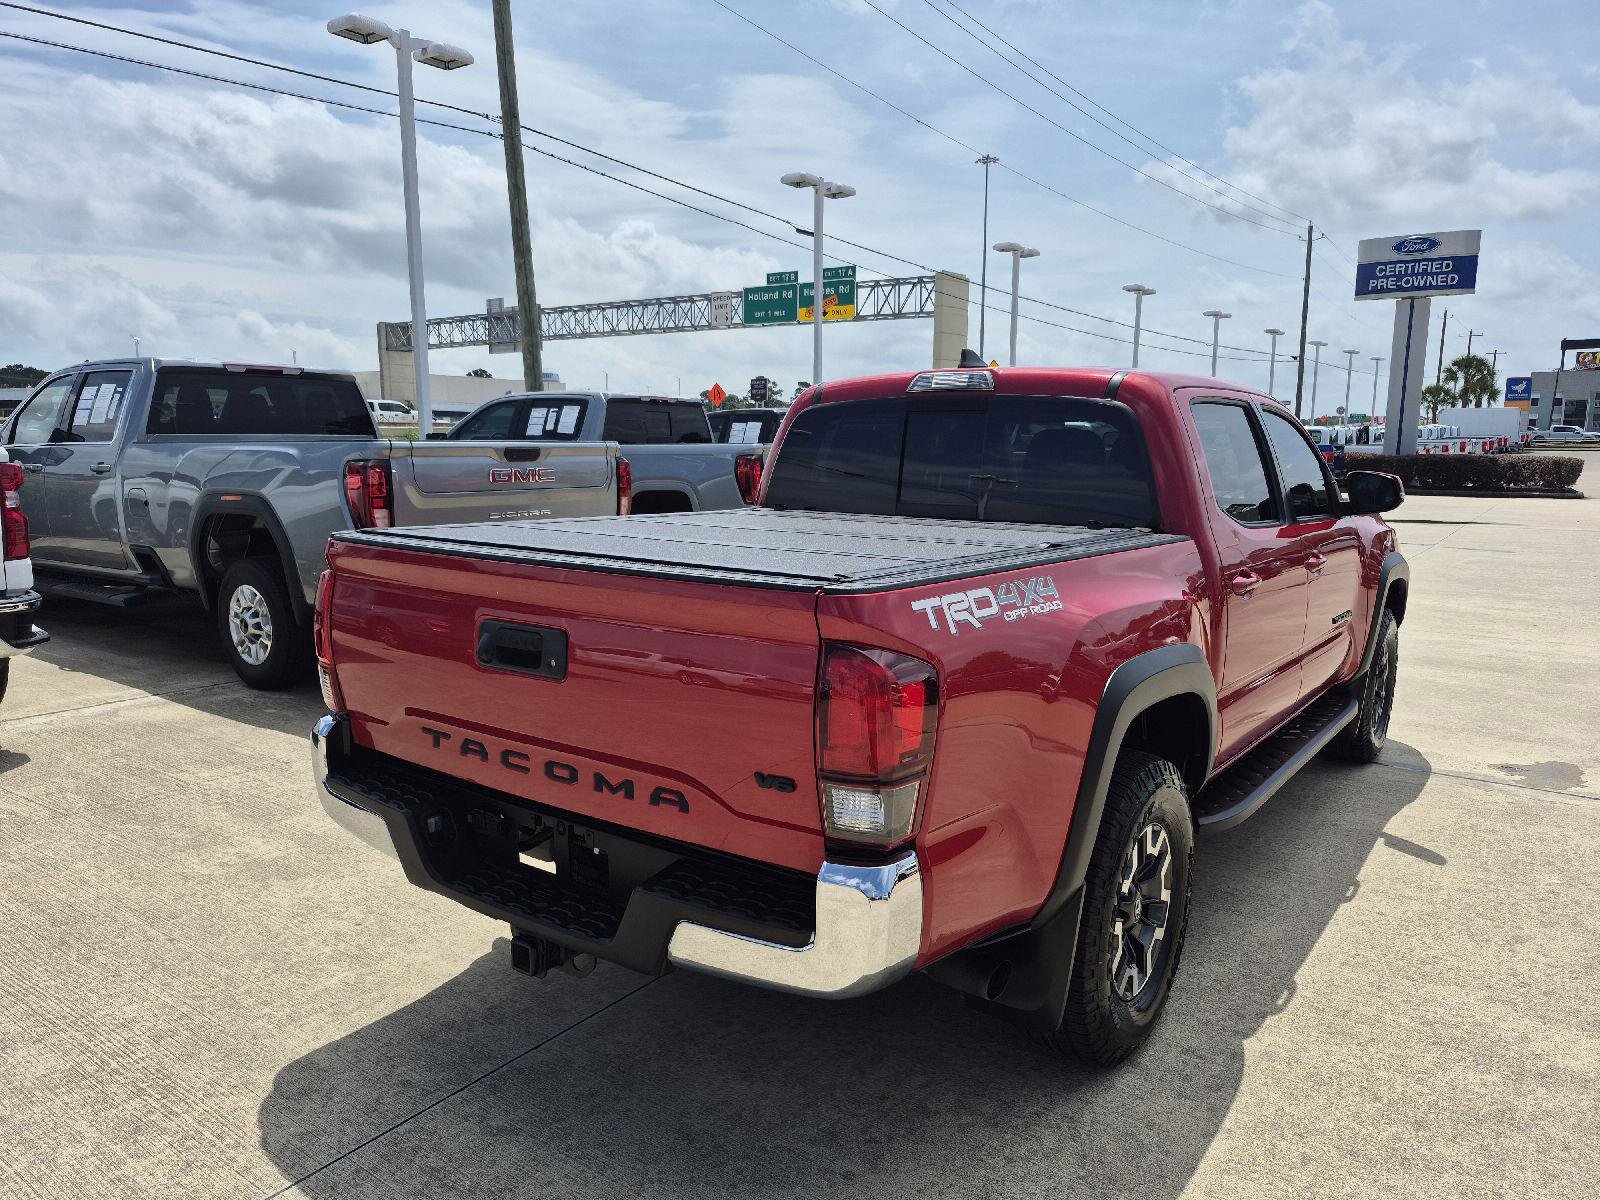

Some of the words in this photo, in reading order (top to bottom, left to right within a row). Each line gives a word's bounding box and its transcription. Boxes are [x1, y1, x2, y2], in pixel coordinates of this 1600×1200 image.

[1401, 239, 1429, 252] Ford
[838, 269, 845, 277] 17
[847, 268, 853, 276] A
[1375, 260, 1453, 277] CERTIFIED
[803, 287, 835, 296] Hues
[839, 284, 850, 294] Rd
[1368, 273, 1459, 290] PRE-OWNED
[748, 290, 779, 301] Holland
[782, 290, 793, 299] Rd
[489, 467, 556, 484] GMC
[911, 587, 1000, 636] TRD
[1003, 607, 1029, 623] OFF
[1030, 600, 1064, 616] ROAD
[421, 726, 690, 815] TACOMA
[753, 771, 799, 794] V6
